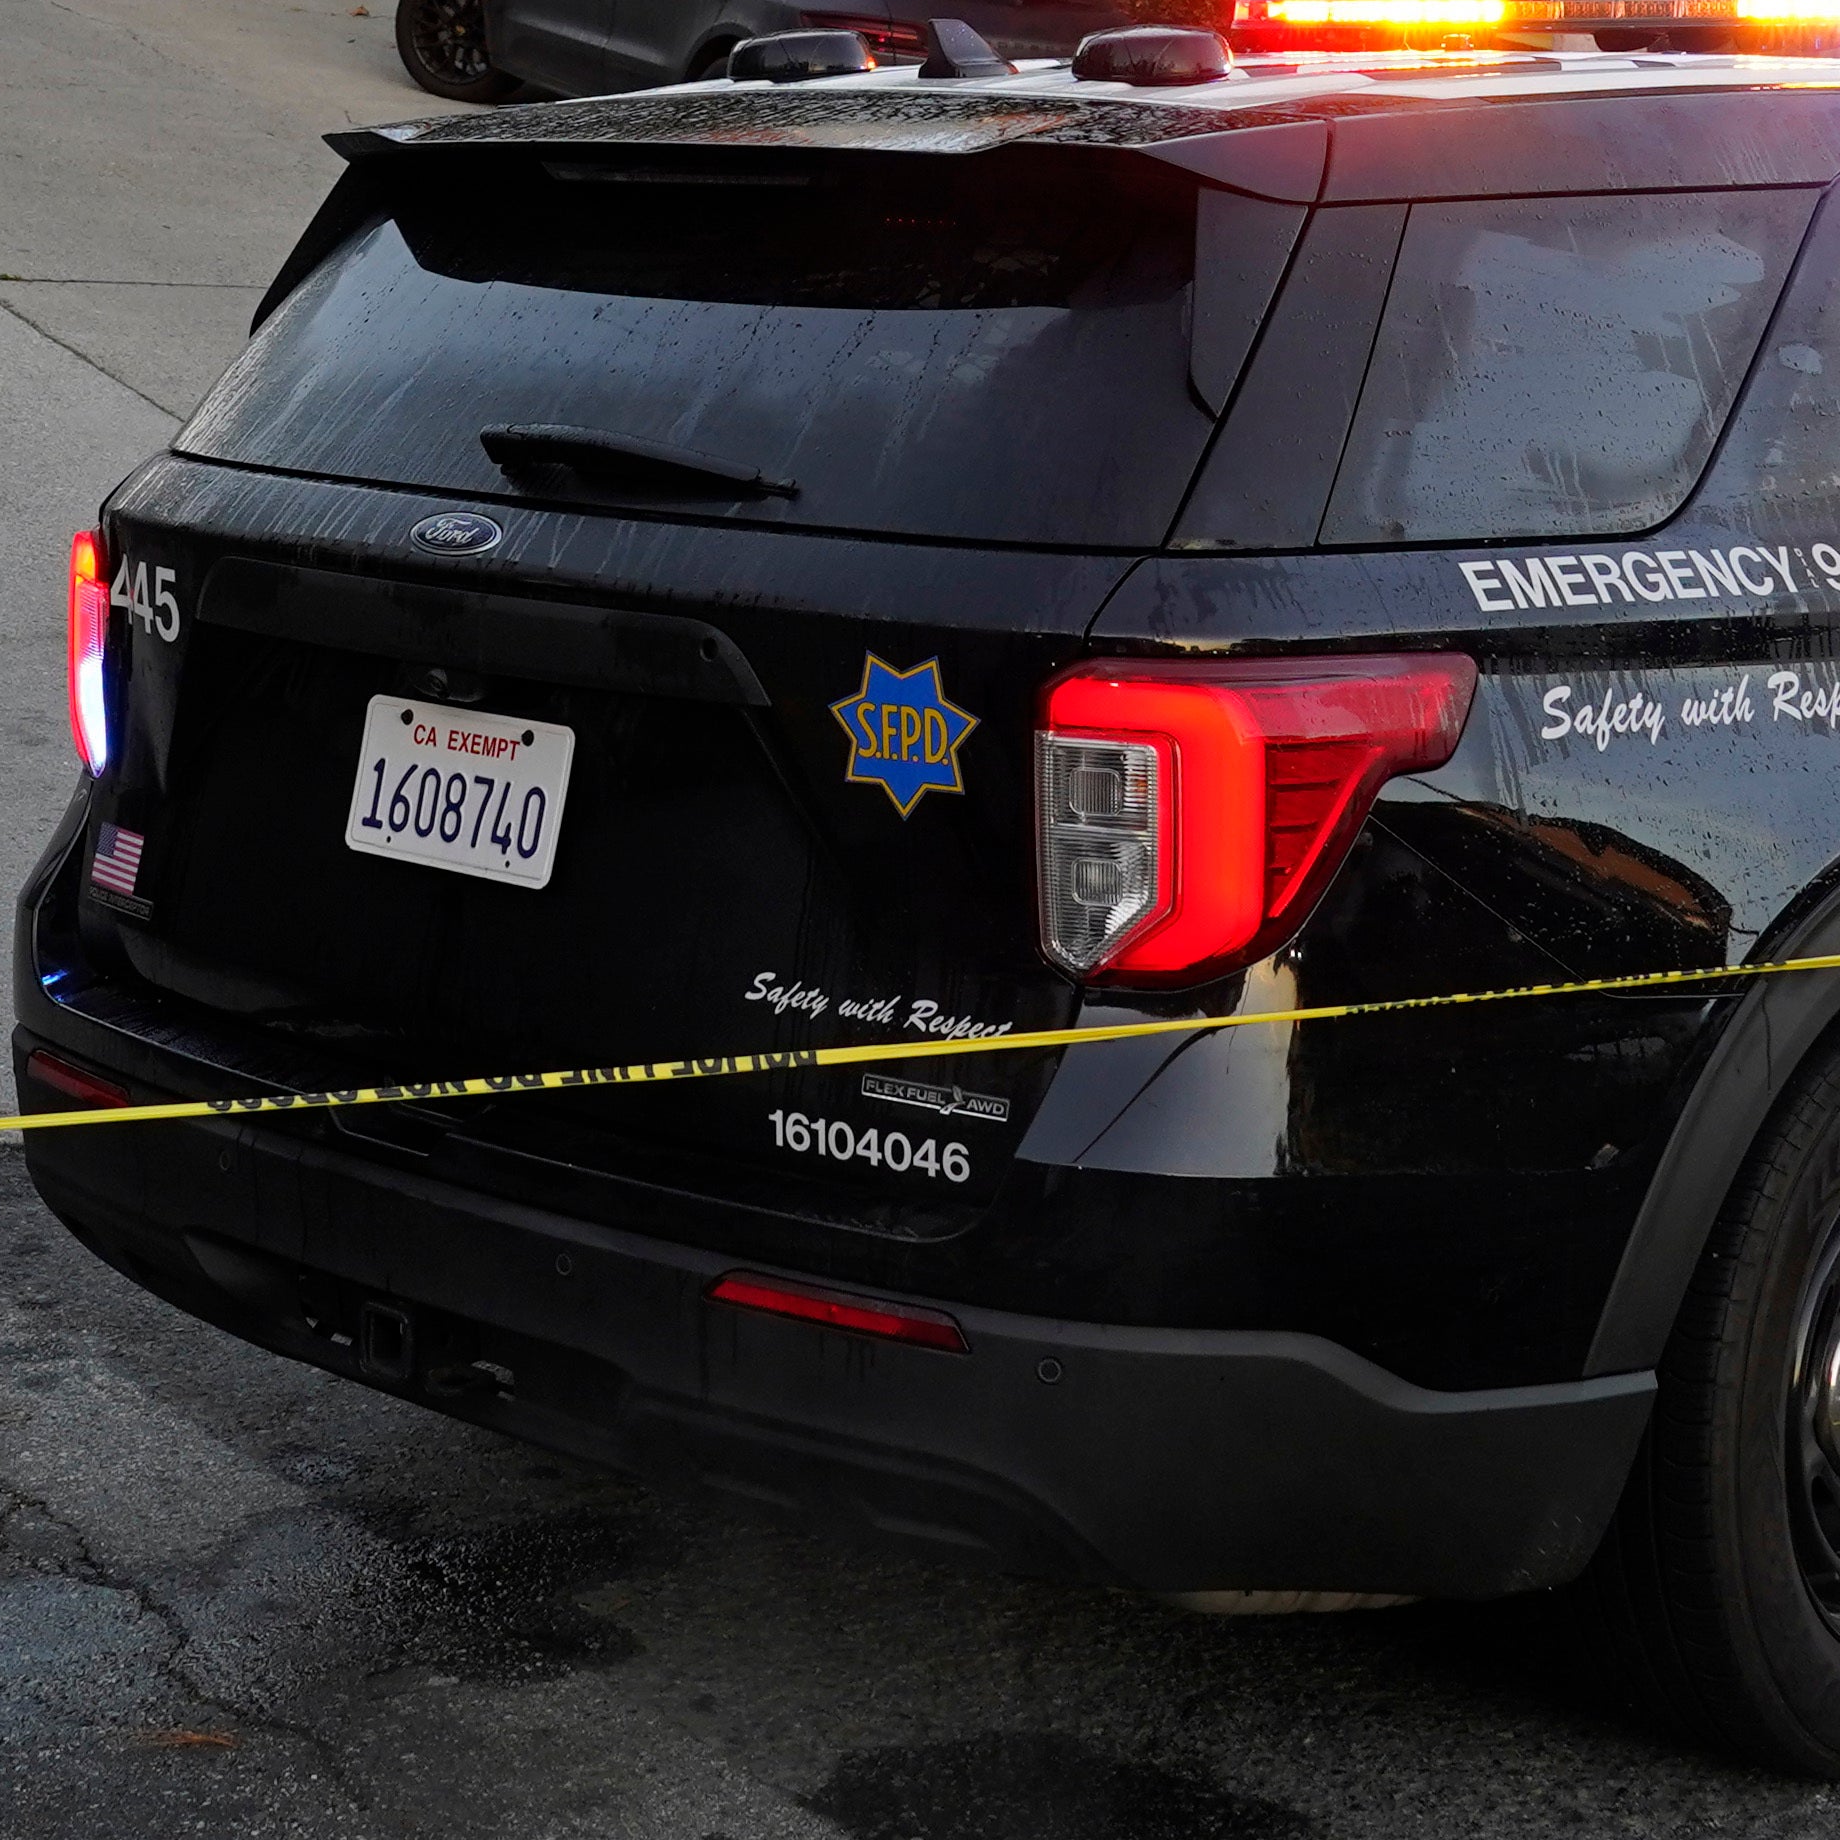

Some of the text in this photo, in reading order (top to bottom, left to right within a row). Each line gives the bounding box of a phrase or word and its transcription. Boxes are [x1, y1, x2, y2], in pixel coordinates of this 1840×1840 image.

[424, 517, 481, 544] Ford
[110, 553, 180, 643] 445
[1458, 545, 1799, 613] EMERGENCY
[413, 723, 521, 761] CA EXEMPT
[856, 700, 950, 766] S.F.P.D.
[1540, 685, 1666, 753] Safety
[1680, 674, 1755, 728] with
[361, 757, 547, 859] 1608740
[744, 972, 1013, 1041] Safety with Respect
[866, 1079, 1005, 1116] FLEX FUEL AWD
[768, 1109, 971, 1183] 16104046
